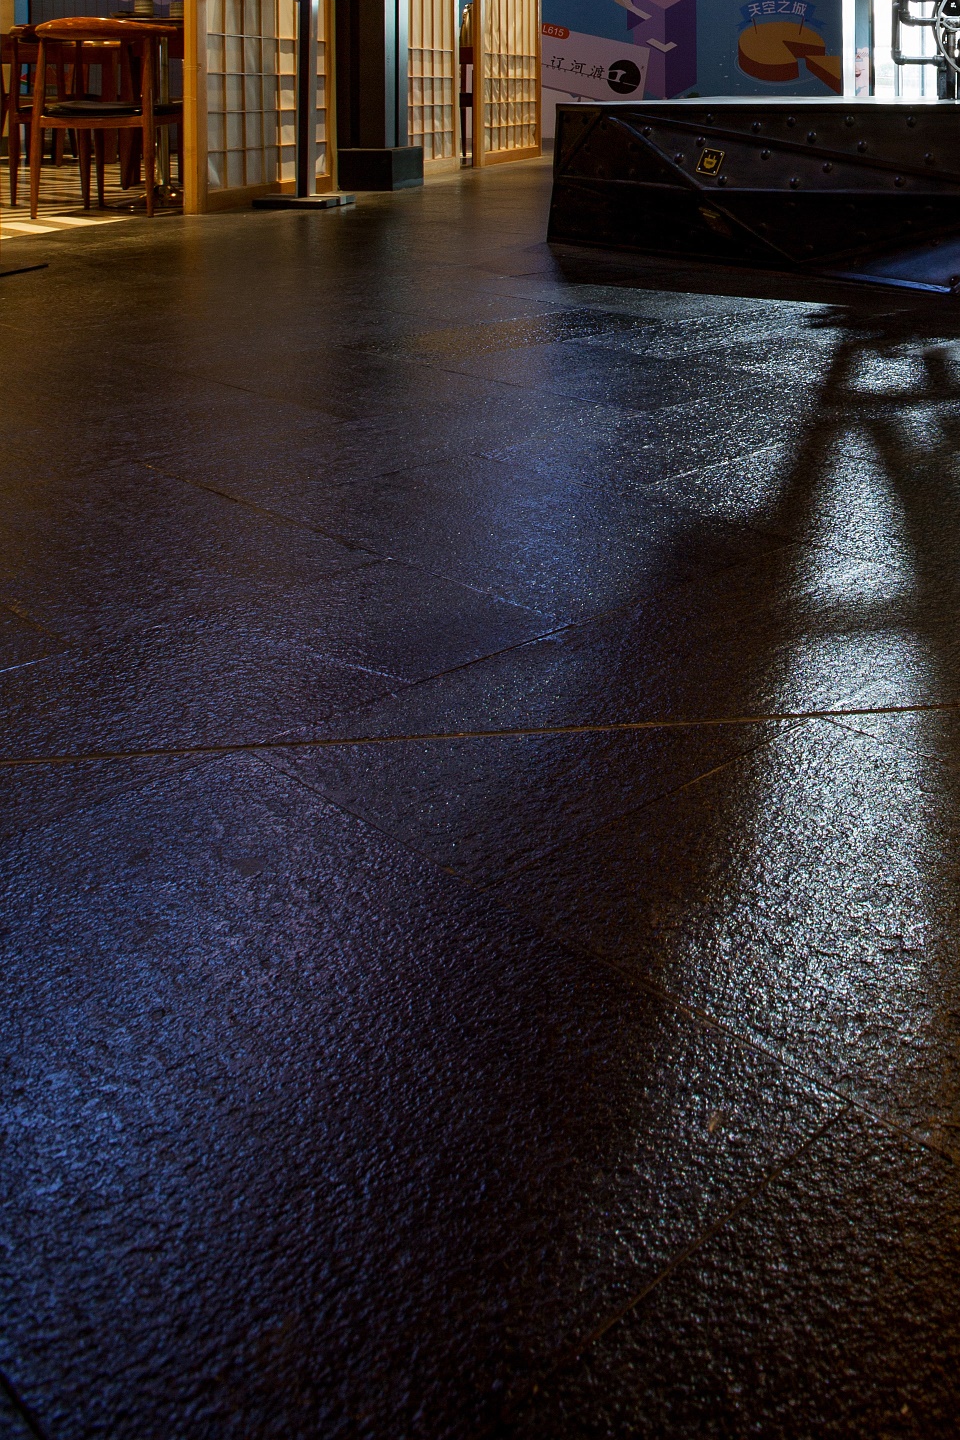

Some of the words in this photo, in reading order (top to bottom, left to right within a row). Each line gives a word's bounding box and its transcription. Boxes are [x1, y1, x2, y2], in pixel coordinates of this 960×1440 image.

[748, 0, 808, 17] 天空之城
[542, 25, 565, 37] L615
